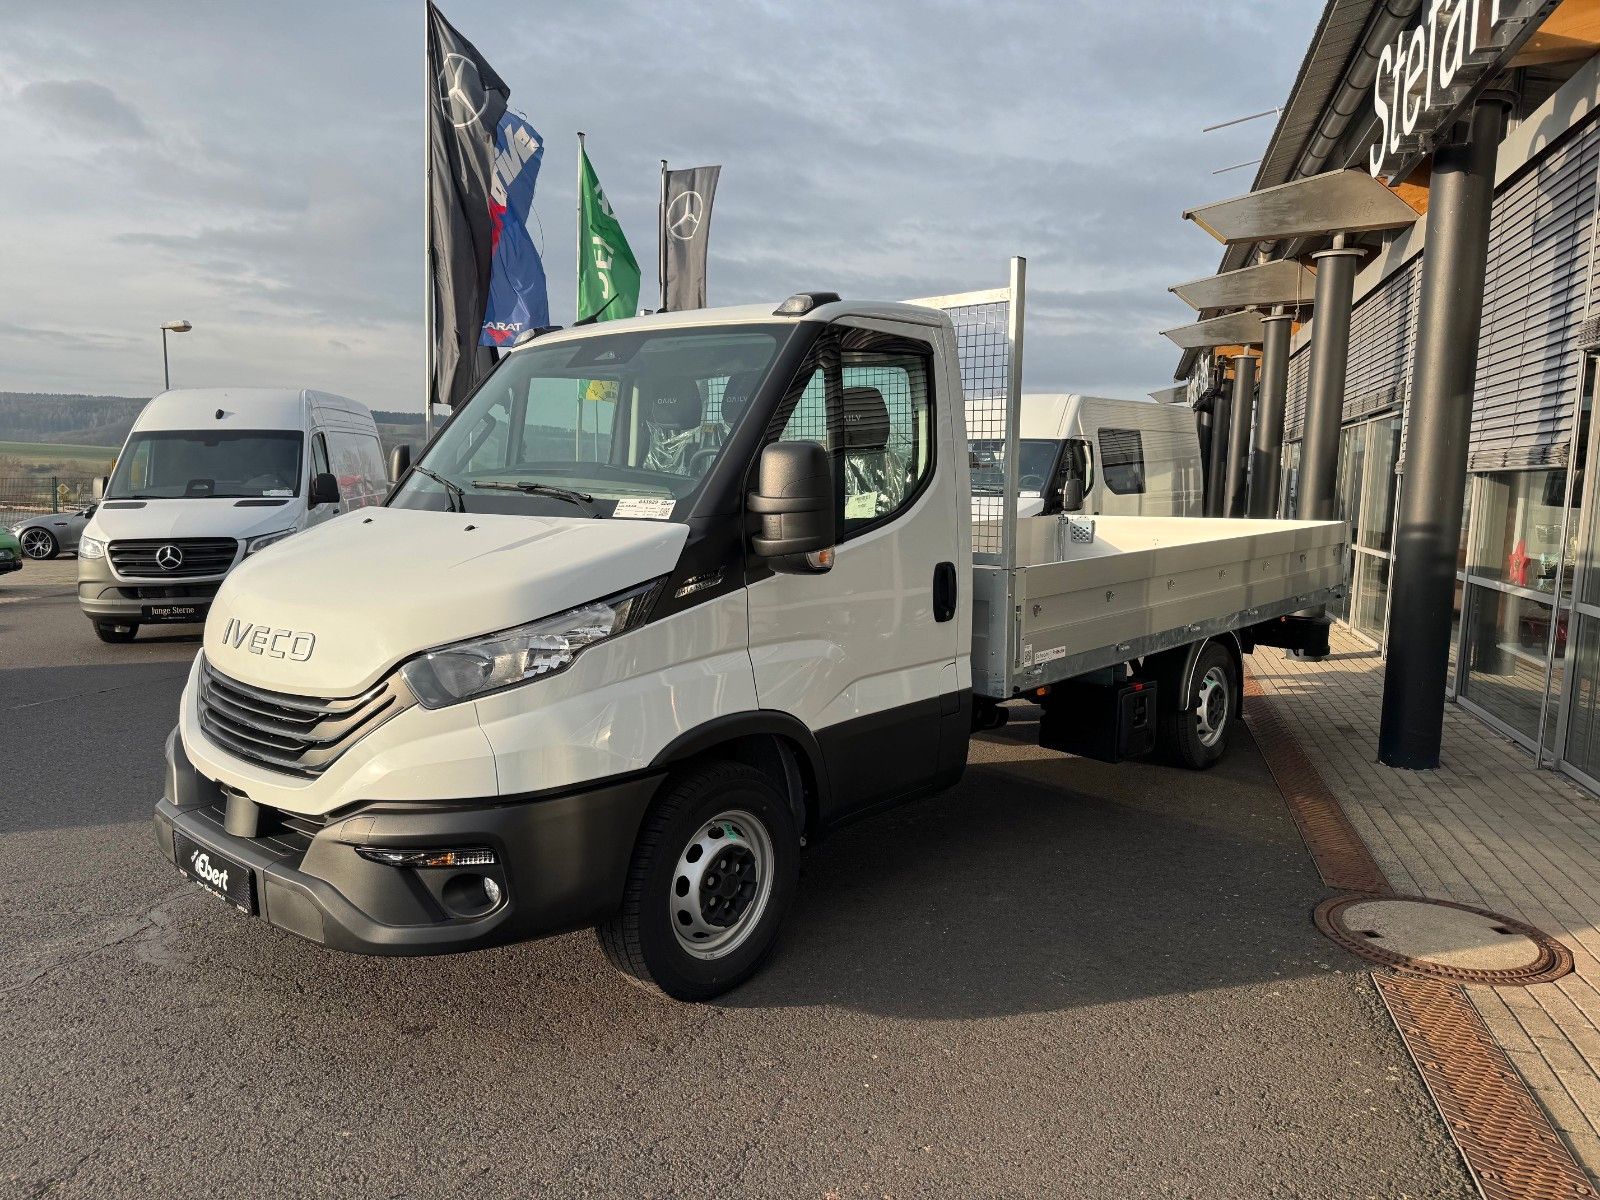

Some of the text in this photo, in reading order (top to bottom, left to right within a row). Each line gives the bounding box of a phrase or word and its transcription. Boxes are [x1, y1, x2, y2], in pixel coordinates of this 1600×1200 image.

[482, 320, 523, 331] ARAT
[657, 397, 679, 405] DAILY
[726, 396, 748, 404] DAILY
[843, 414, 862, 423] AILY
[151, 606, 195, 616] Junge Sterne
[222, 617, 316, 662] IVECO
